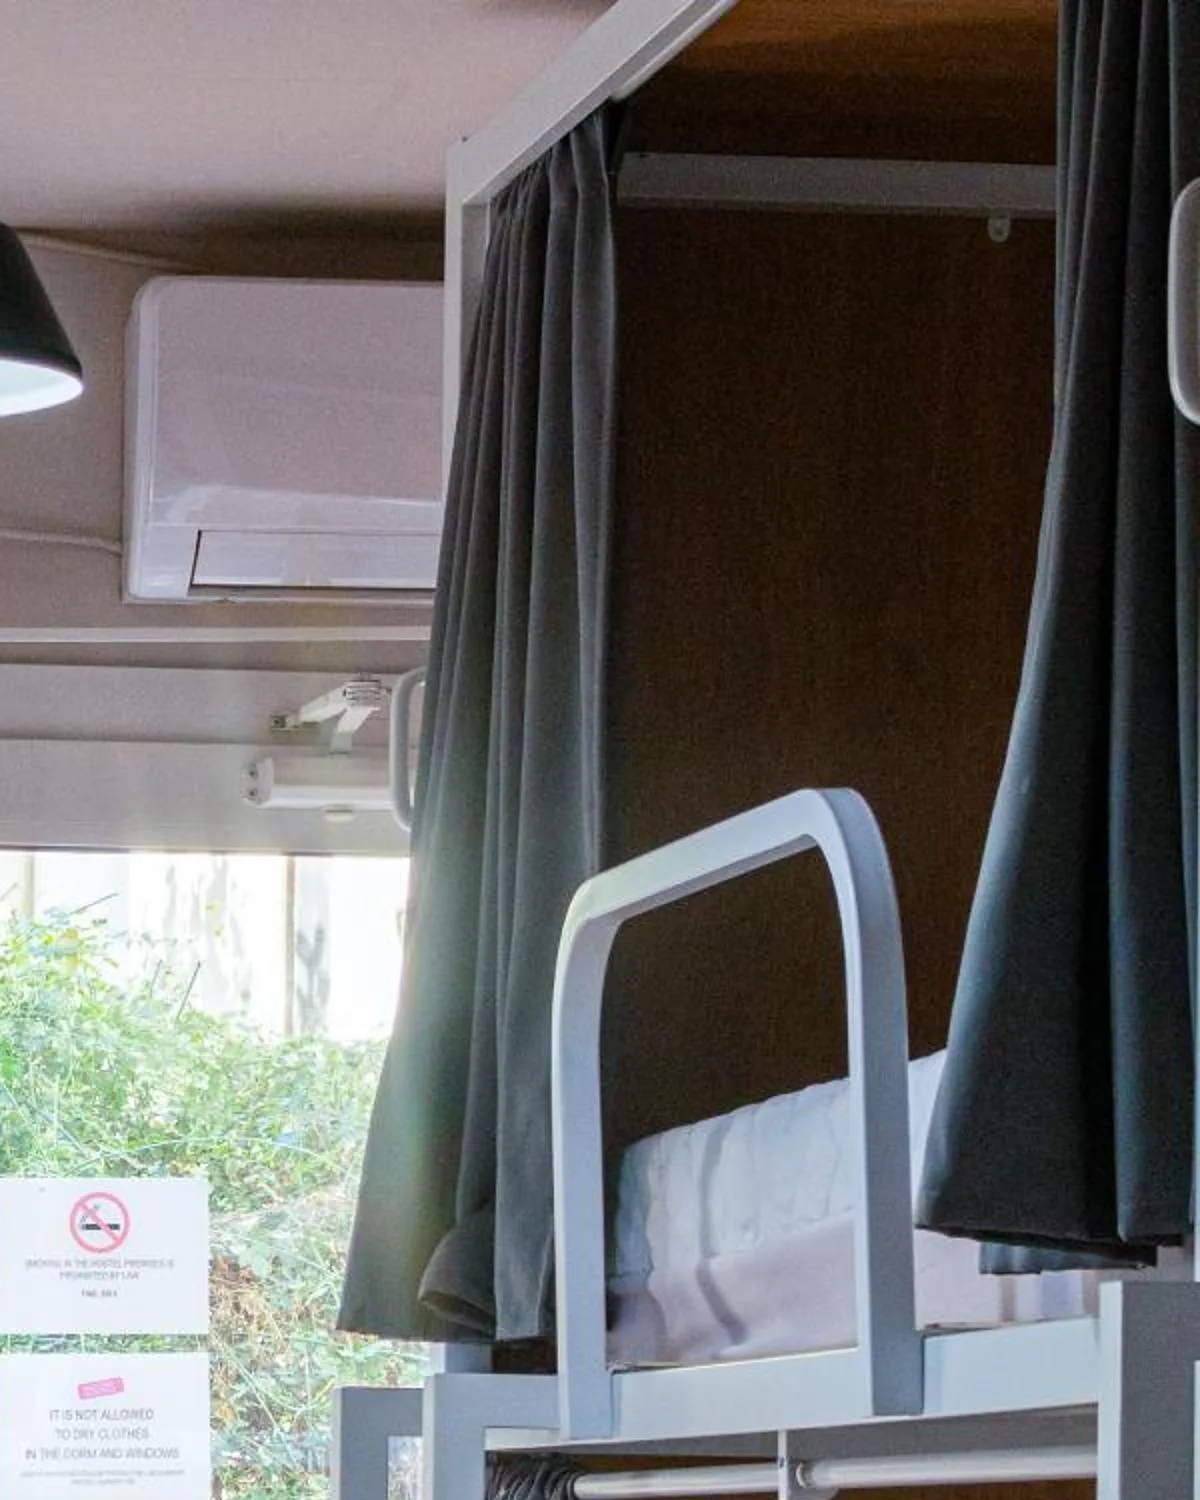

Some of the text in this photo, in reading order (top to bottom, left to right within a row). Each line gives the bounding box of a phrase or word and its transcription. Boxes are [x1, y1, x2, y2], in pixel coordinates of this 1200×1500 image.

[49, 1407, 155, 1421] IT IS NOT ALLOWED
[56, 1427, 150, 1440] TO DRY CLOTHES
[25, 1447, 180, 1460] IN THE DORM AND WINDOWS
